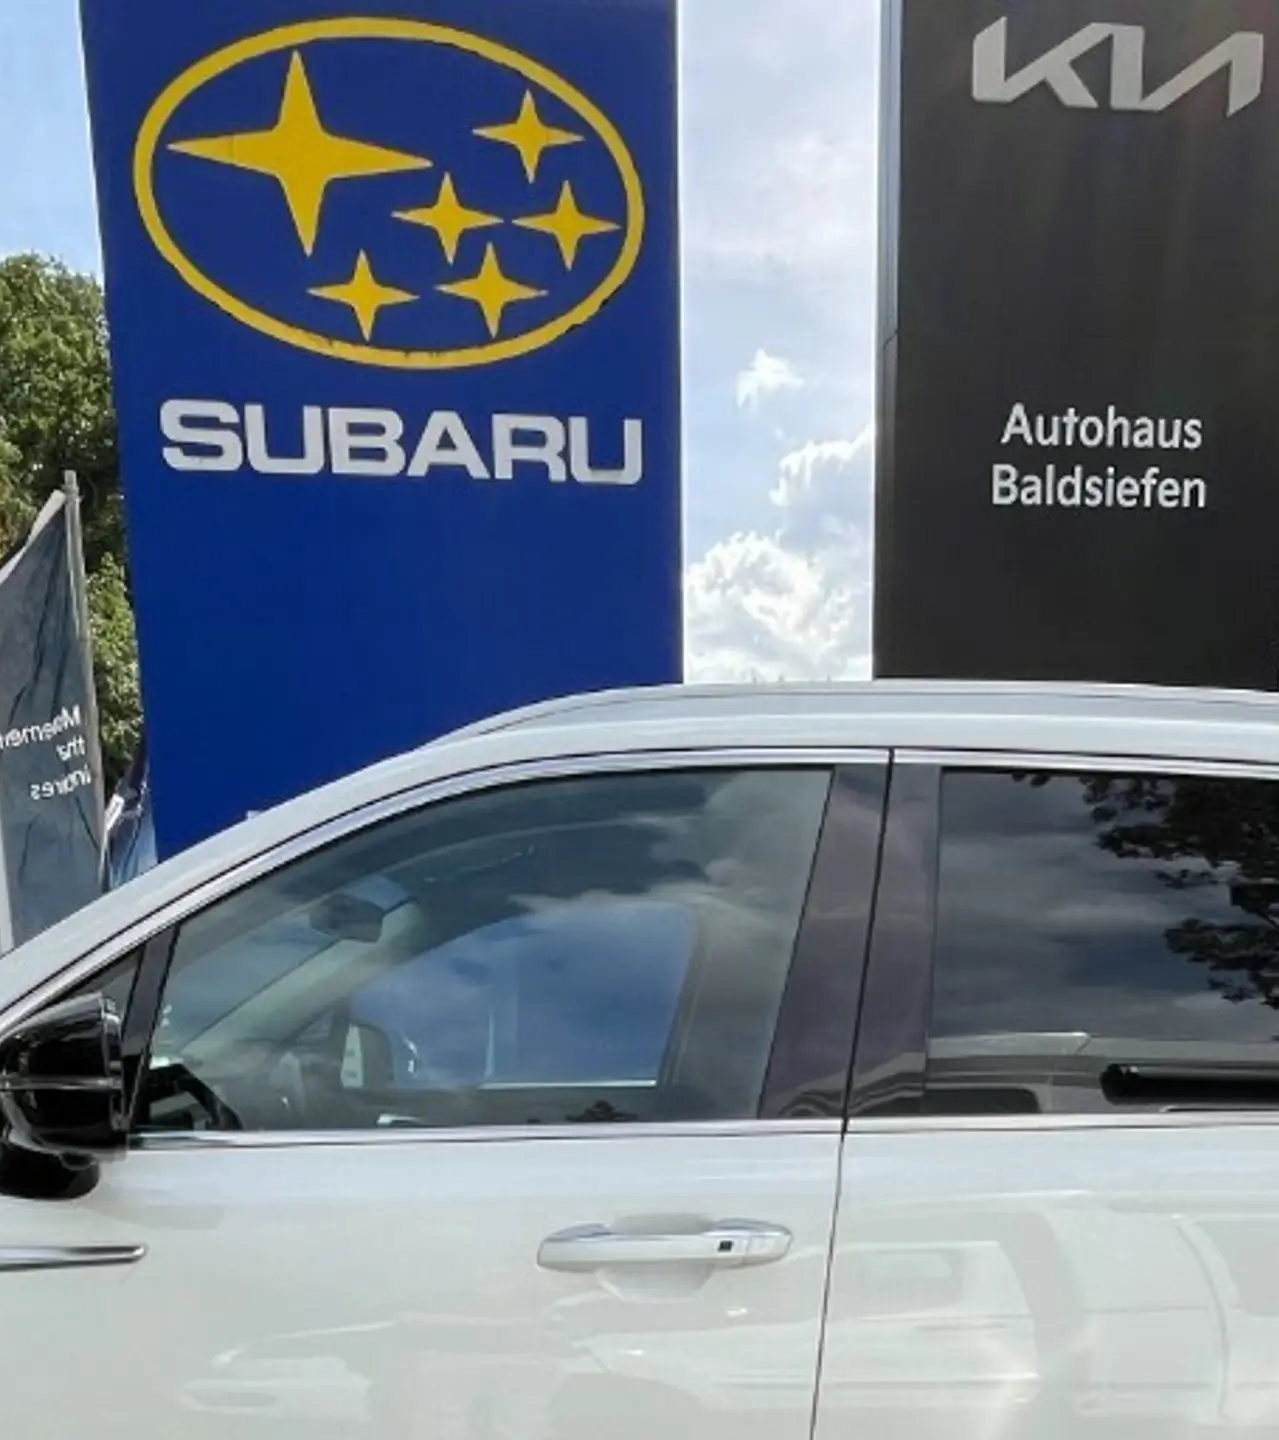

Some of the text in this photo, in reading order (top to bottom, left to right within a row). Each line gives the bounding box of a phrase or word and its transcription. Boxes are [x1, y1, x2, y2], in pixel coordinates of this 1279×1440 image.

[972, 16, 1263, 117] KIA
[160, 399, 642, 485] SUBARU
[1000, 402, 1203, 450] Autohaus
[991, 463, 1207, 508] Baldsiefen
